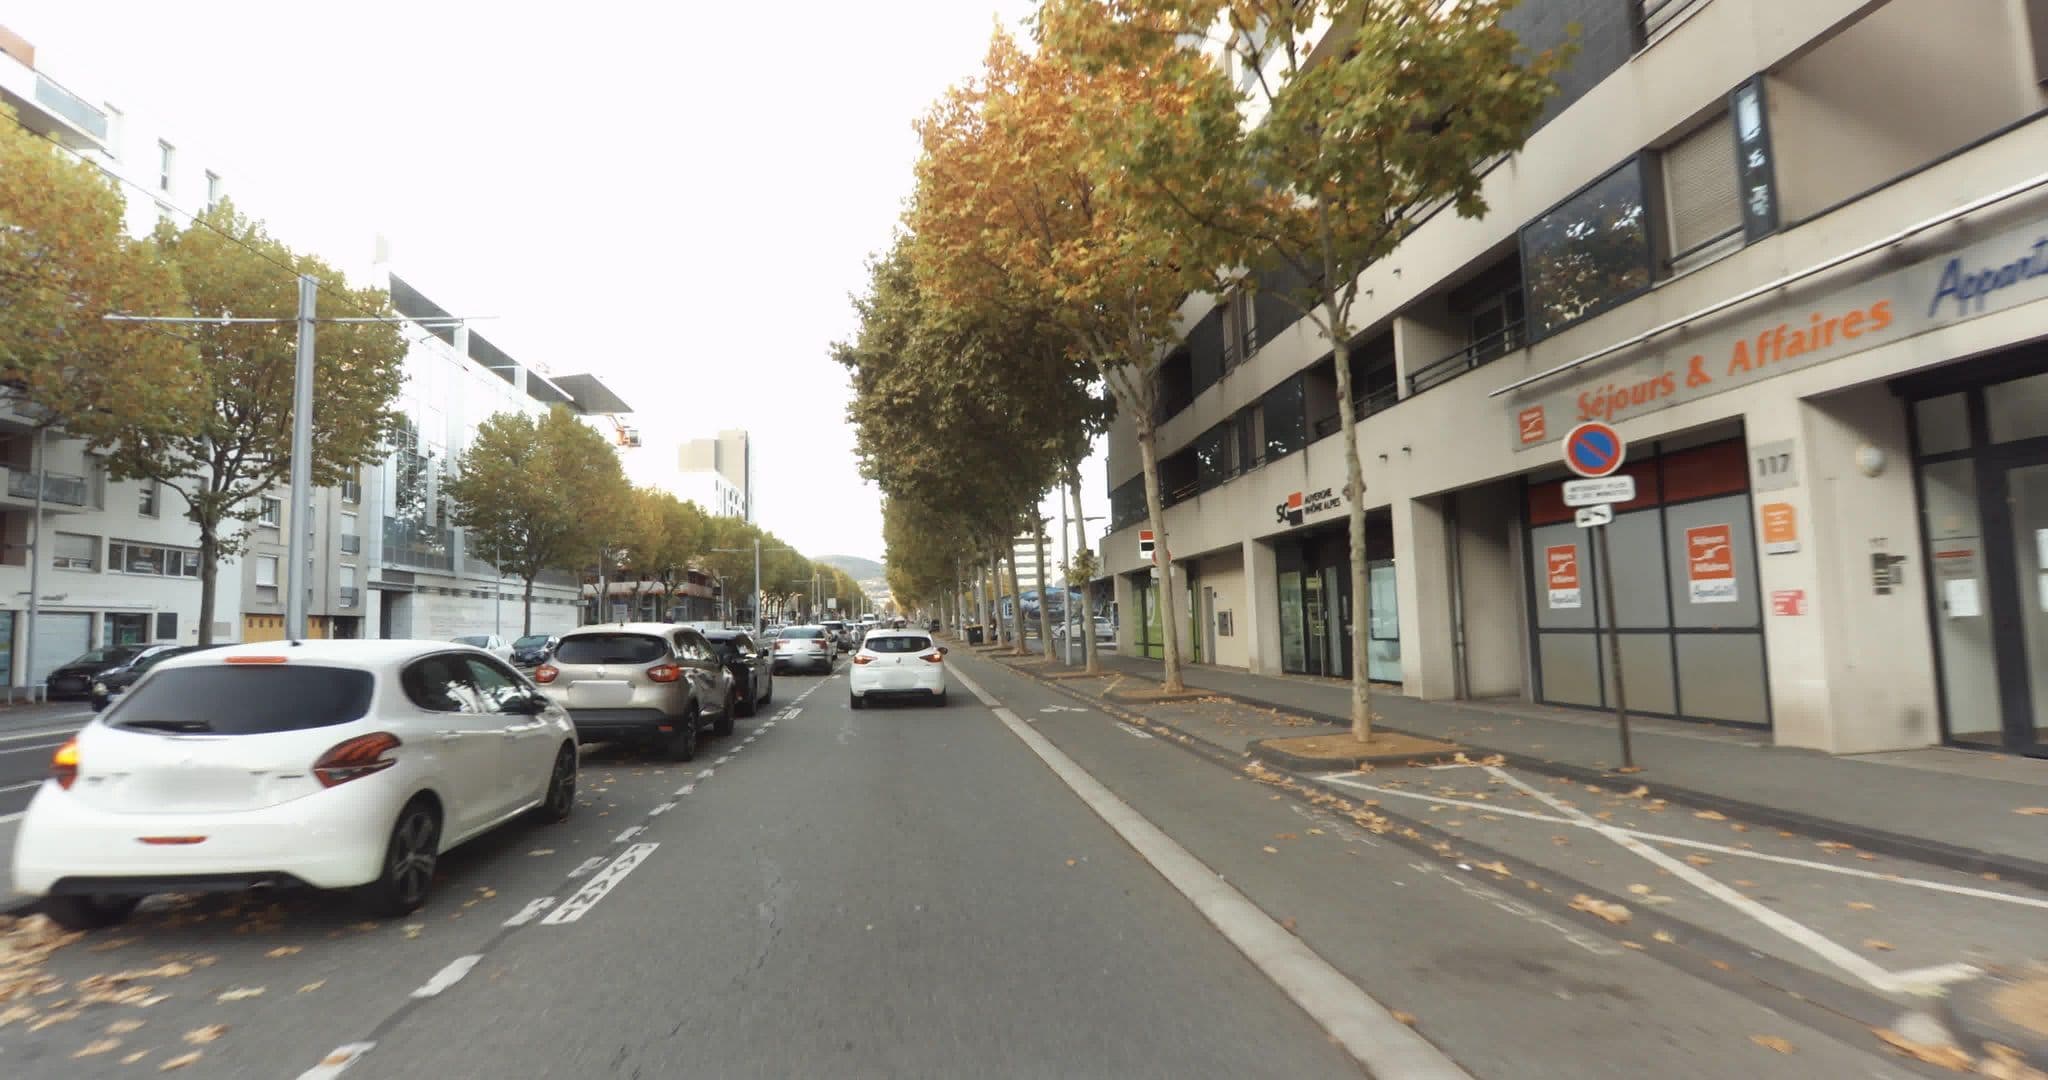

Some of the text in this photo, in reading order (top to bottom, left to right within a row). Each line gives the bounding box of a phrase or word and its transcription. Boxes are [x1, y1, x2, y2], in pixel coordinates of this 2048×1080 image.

[1576, 299, 1894, 420] Séjours & Affaires
[1757, 452, 1790, 476] 117
